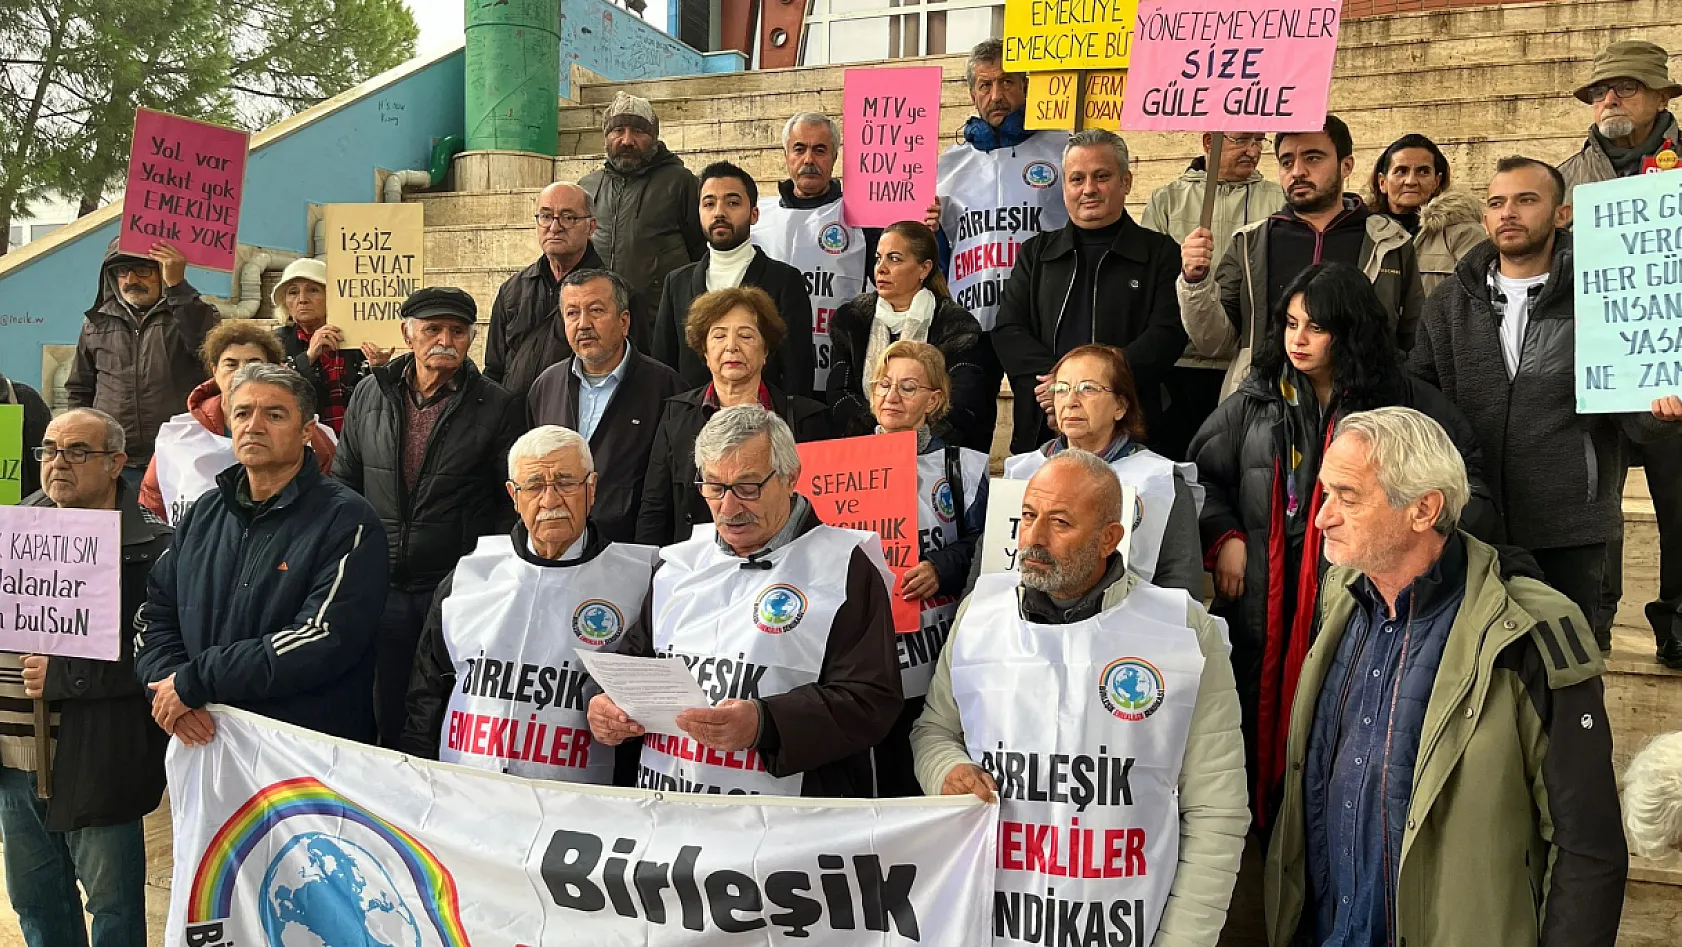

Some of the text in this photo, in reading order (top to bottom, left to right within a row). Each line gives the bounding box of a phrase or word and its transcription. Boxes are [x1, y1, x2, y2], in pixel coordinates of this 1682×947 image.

[1138, 7, 1336, 41] YÖNETEMEYENLER
[1006, 28, 1098, 64] EMEKÇİYE
[1181, 43, 1264, 79] SİZE
[1049, 75, 1072, 95] OY
[1142, 80, 1296, 117] GÜLE GÜLE
[862, 96, 926, 124] MTV ye
[1037, 96, 1069, 120] SENİ
[861, 120, 924, 152] ÖTV ye
[195, 152, 232, 171] var
[860, 152, 924, 179] KDV ye
[201, 179, 235, 201] yok
[869, 180, 915, 202] HAYIR
[1594, 183, 1682, 228] HER G
[959, 201, 1043, 242] BİRLEŞİK
[188, 225, 236, 254] YOK!
[355, 254, 416, 274] EVLAT
[1583, 254, 1682, 295] HER GÜ
[957, 273, 1008, 311] SENDİ
[1586, 365, 1616, 390] NE
[811, 467, 893, 496] SEFALET
[835, 499, 860, 515] ve
[10, 532, 99, 565] KAPATILSIN
[462, 650, 589, 711] BİRLEŞİK
[447, 711, 591, 769] EMEKLİLER
[982, 741, 1136, 812] BİRLEŞİK
[996, 816, 1147, 879] EKLİLER
[541, 829, 921, 942] Birleşik
[992, 887, 1145, 947] NDİKASI
